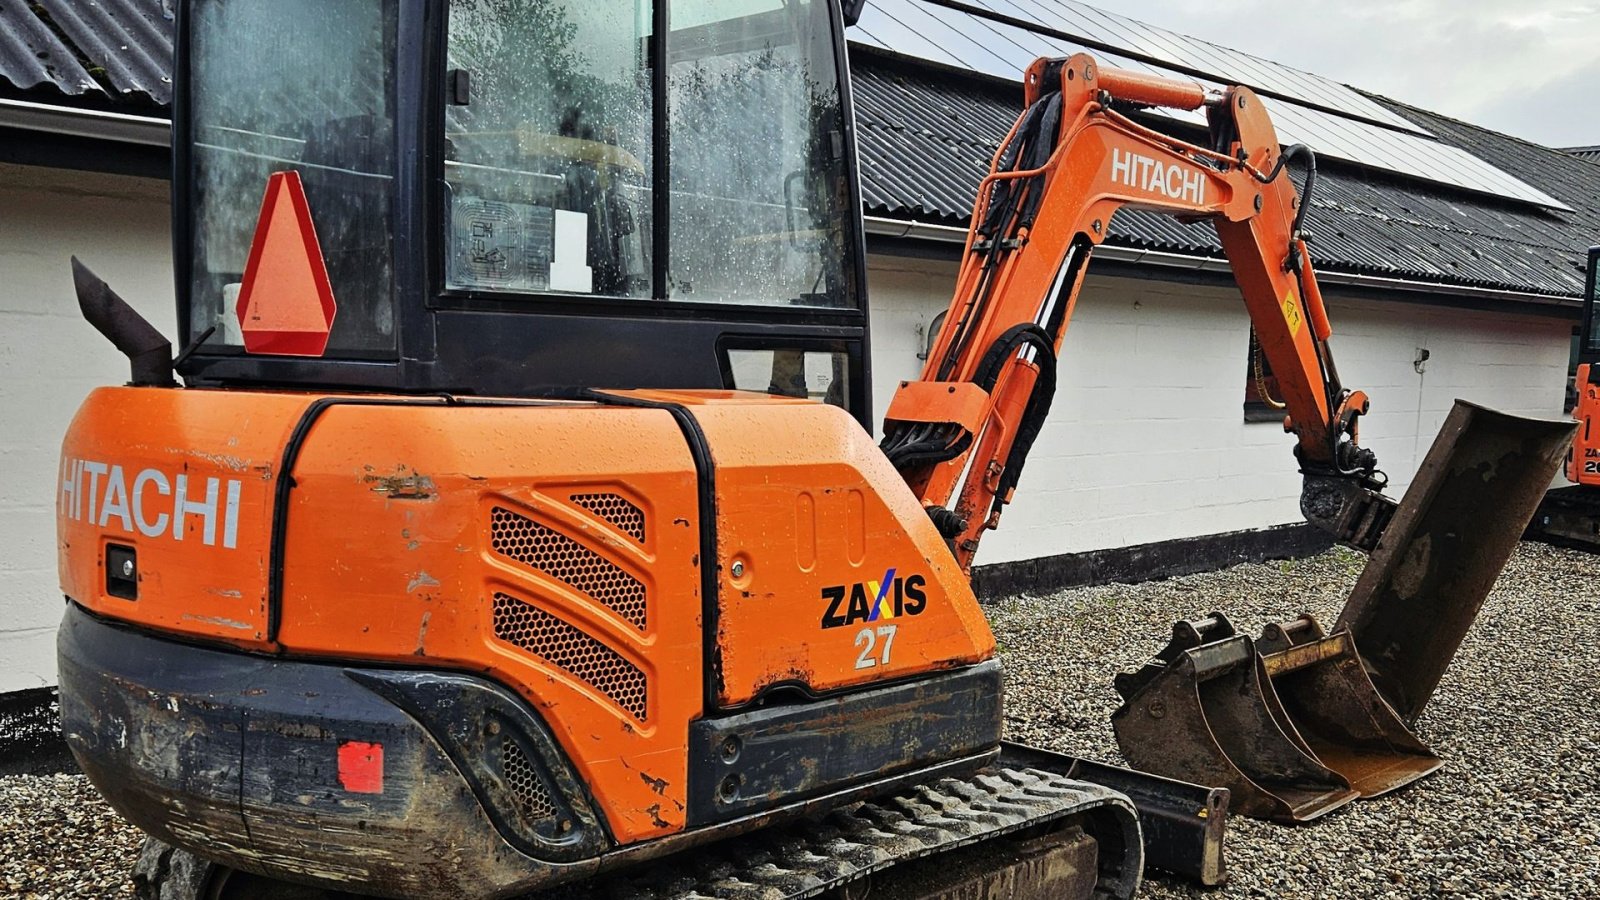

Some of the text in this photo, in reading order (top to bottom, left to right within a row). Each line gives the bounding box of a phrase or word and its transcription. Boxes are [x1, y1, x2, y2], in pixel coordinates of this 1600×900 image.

[1111, 147, 1206, 205] HITACHI
[61, 455, 241, 549] HITACHI
[821, 568, 927, 630] ZAXIS
[854, 624, 897, 670] 27
